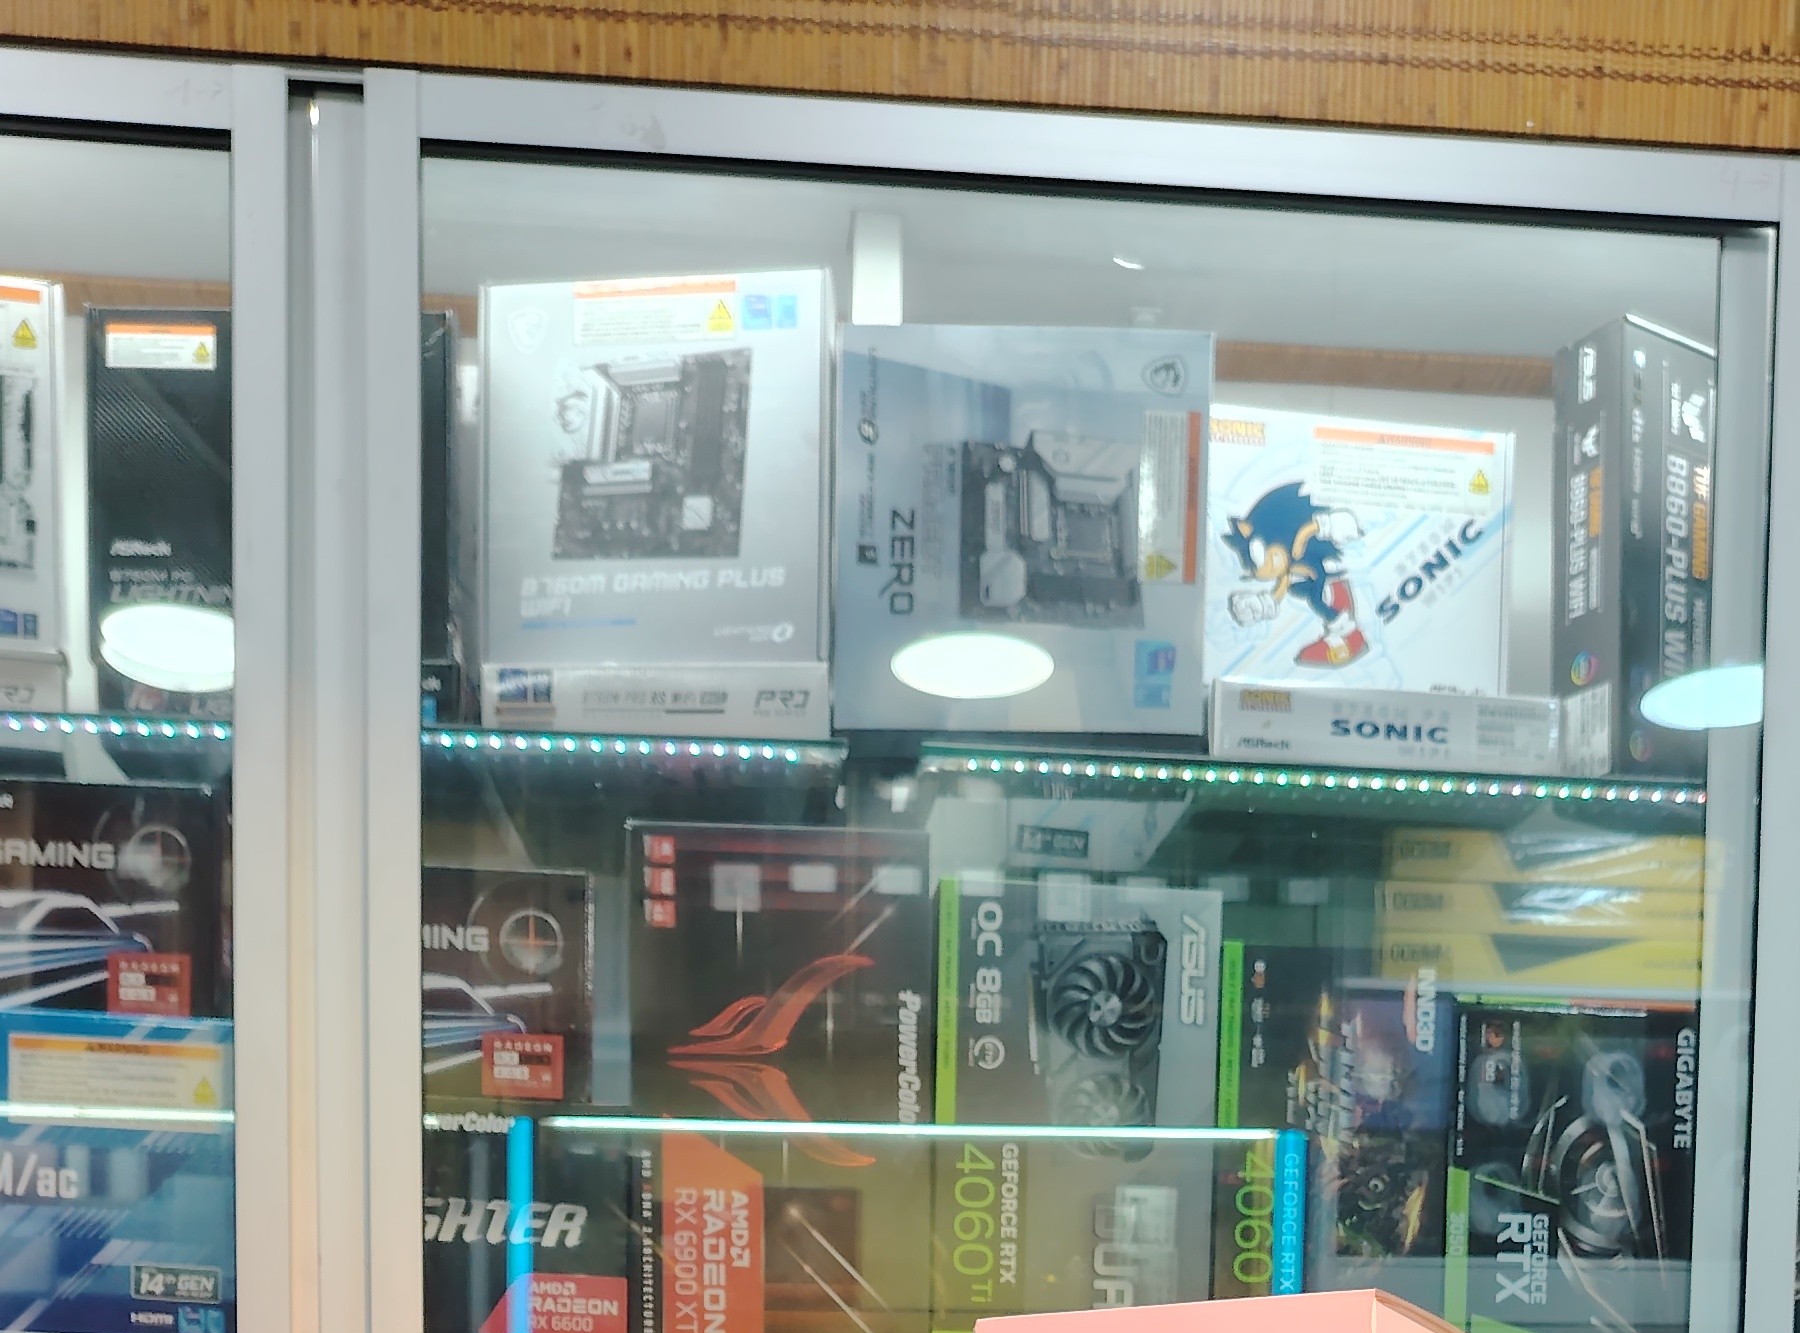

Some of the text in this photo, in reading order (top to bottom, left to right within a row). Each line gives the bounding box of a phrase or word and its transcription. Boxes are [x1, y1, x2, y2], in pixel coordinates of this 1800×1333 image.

[613, 570, 710, 592] GAMING
[717, 566, 786, 588] PLUS
[879, 509, 914, 616] ZERO
[1375, 518, 1484, 626] SONIC
[1330, 719, 1449, 744] SONIC
[0, 839, 116, 870] AMING
[977, 901, 1003, 957] OC
[1180, 914, 1205, 1026] ASUS
[1673, 1027, 1699, 1150] GIGABYTE
[675, 1188, 698, 1224] RX
[731, 1189, 750, 1247] AMD
[953, 1143, 996, 1303] 4060 Ti
[999, 1143, 1020, 1285] GEFORCE RTX
[1233, 1150, 1275, 1283] 4060
[1280, 1153, 1298, 1294] GEFORCE RTX
[674, 1229, 698, 1296] 6900
[1495, 1211, 1532, 1305] RTX
[1530, 1213, 1549, 1305] GEFORCE
[530, 1297, 618, 1316] RADEON
[530, 1317, 593, 1332] RX 6600
